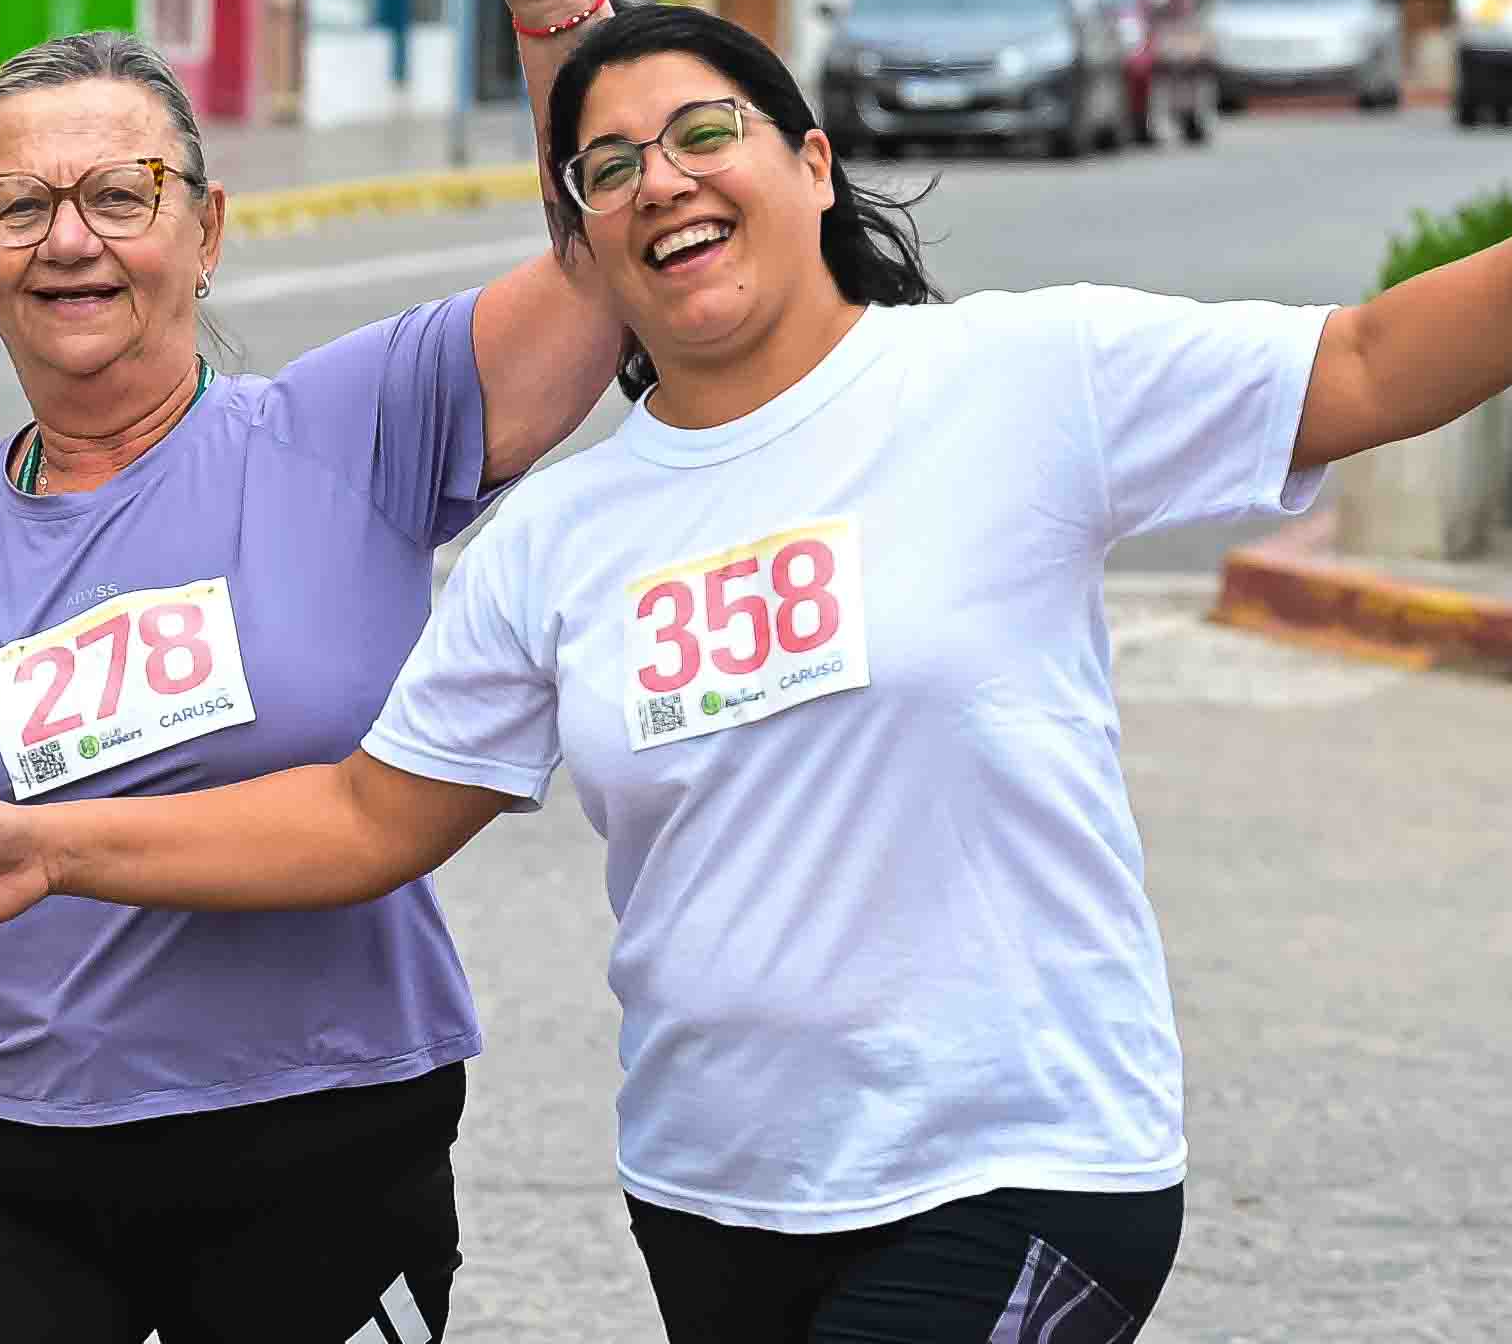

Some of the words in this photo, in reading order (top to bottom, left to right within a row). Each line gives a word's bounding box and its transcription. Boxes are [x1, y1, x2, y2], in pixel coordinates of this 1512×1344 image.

[637, 539, 840, 693] 358
[14, 603, 213, 747] 278
[159, 696, 229, 728] CARUSO
[779, 658, 843, 689] CARUSO
